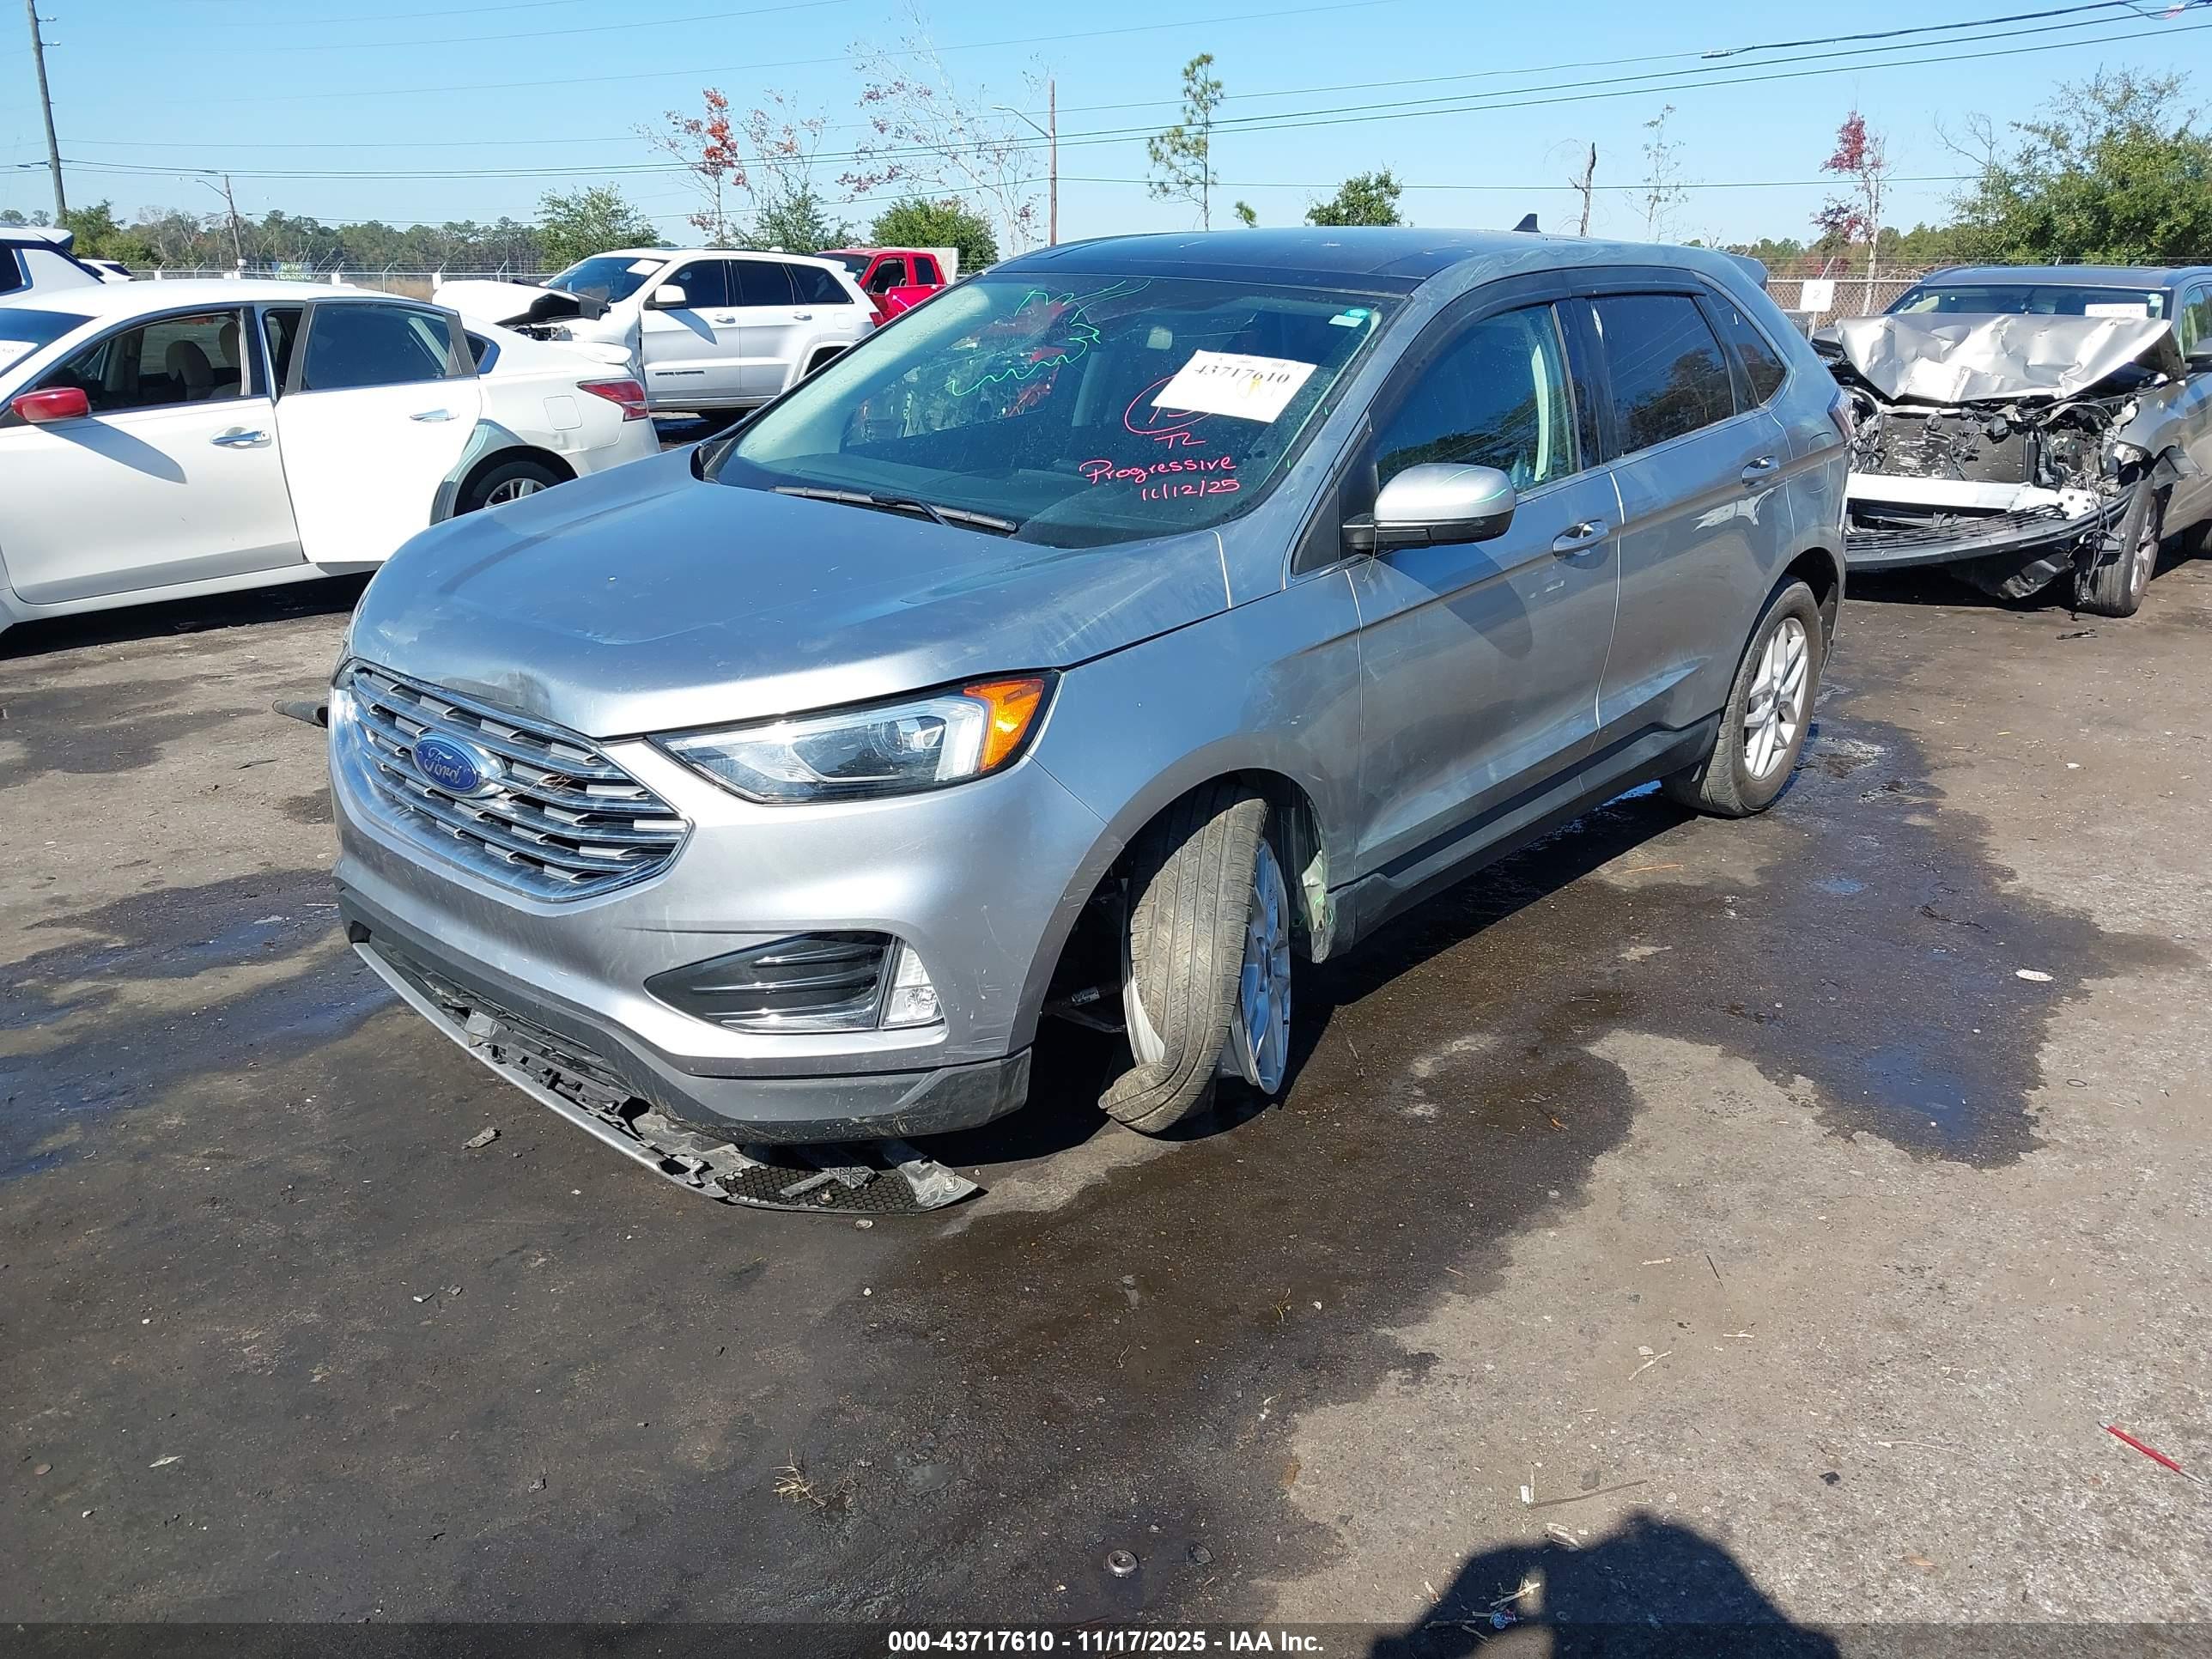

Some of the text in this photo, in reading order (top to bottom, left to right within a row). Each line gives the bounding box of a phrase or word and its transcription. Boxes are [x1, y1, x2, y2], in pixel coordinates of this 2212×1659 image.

[1813, 289, 1821, 300] 2
[1194, 364, 1291, 384] 43717610
[1079, 456, 1237, 484] Progressive
[424, 746, 462, 784] Ford
